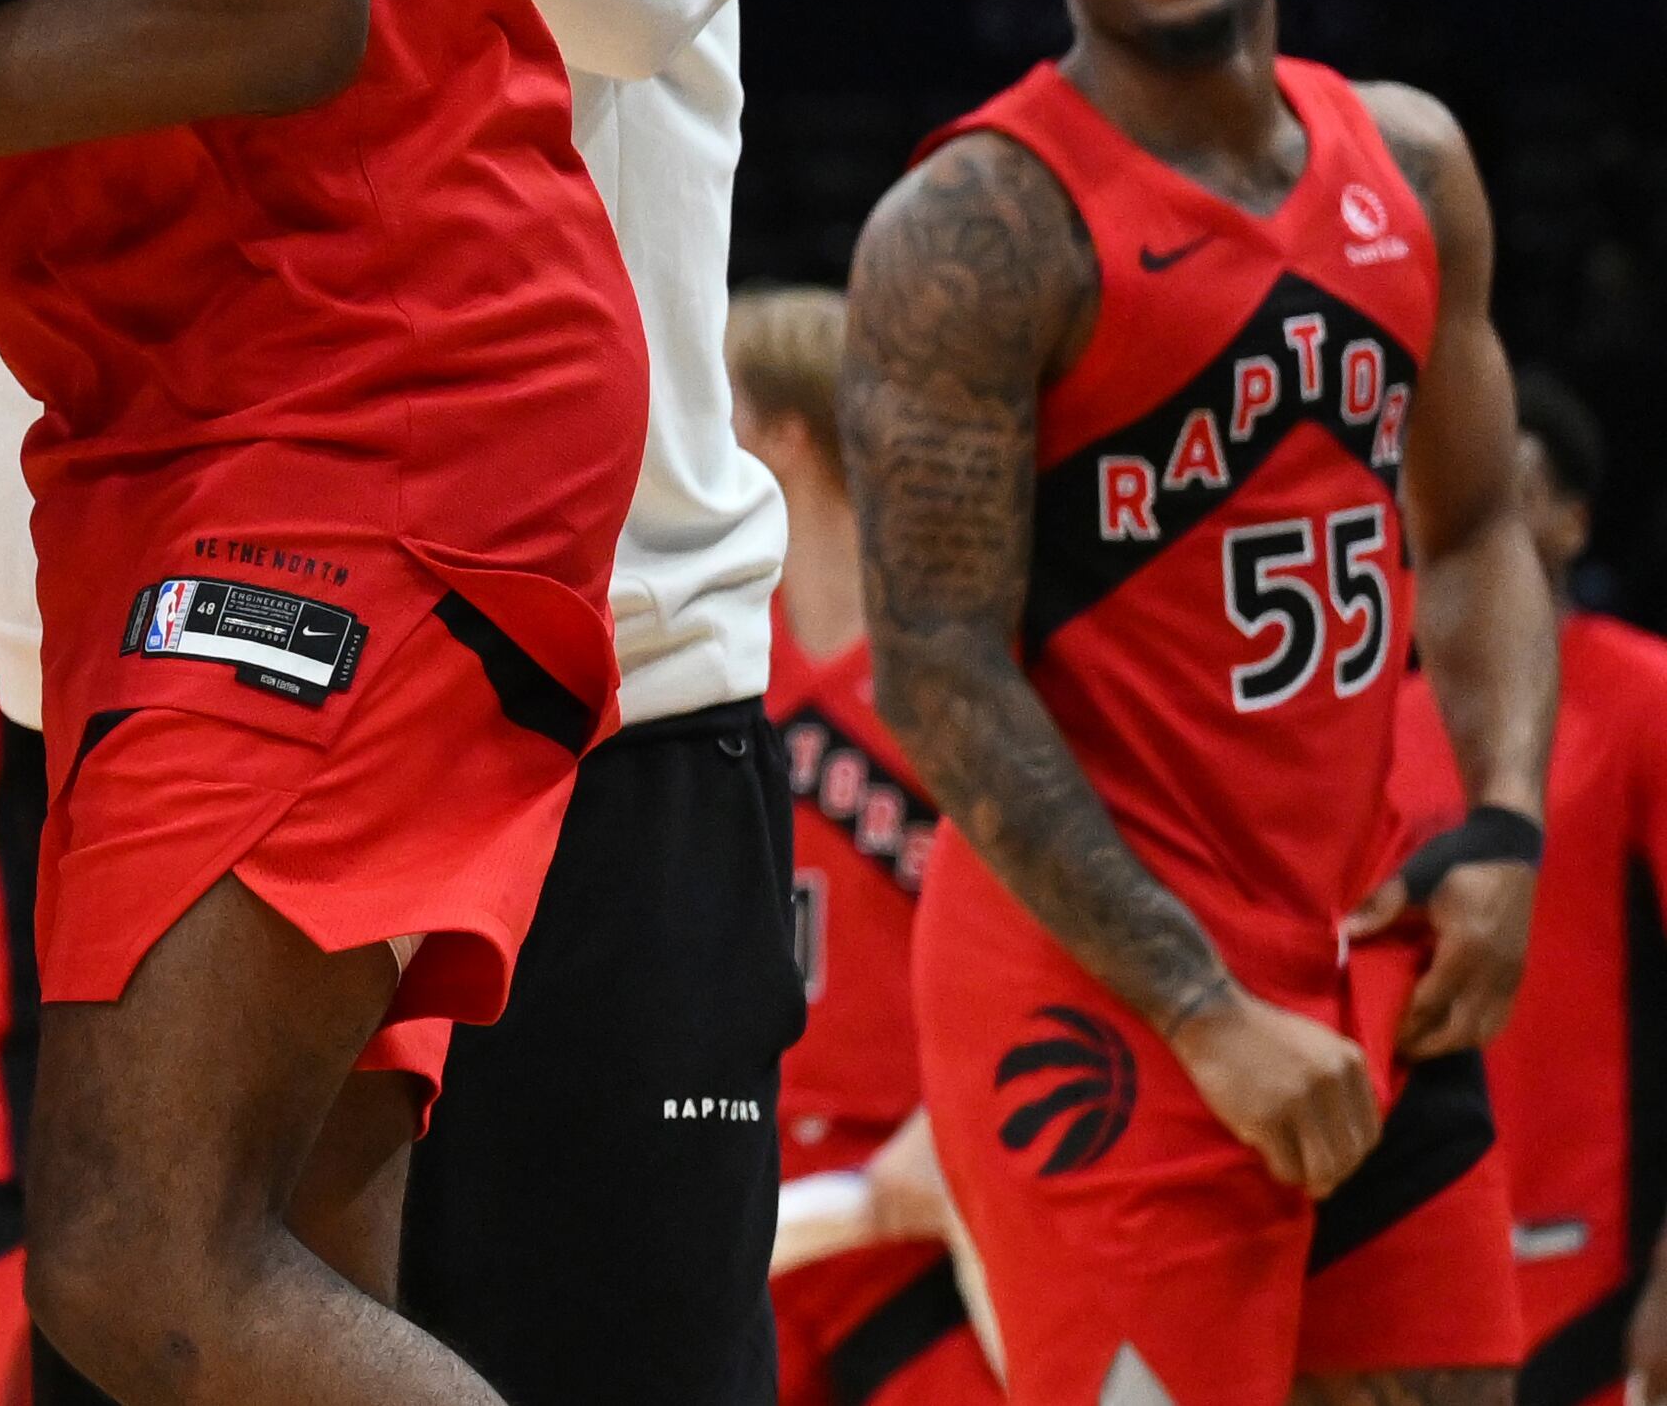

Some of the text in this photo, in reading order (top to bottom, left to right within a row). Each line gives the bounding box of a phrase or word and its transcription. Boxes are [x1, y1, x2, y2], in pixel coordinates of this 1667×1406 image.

[1098, 312, 1410, 542] RAPTOR
[195, 537, 349, 587] WE THE NORTH
[197, 601, 216, 616] 48
[1222, 503, 1392, 715] 55
[663, 1097, 761, 1122] RAPTORS
